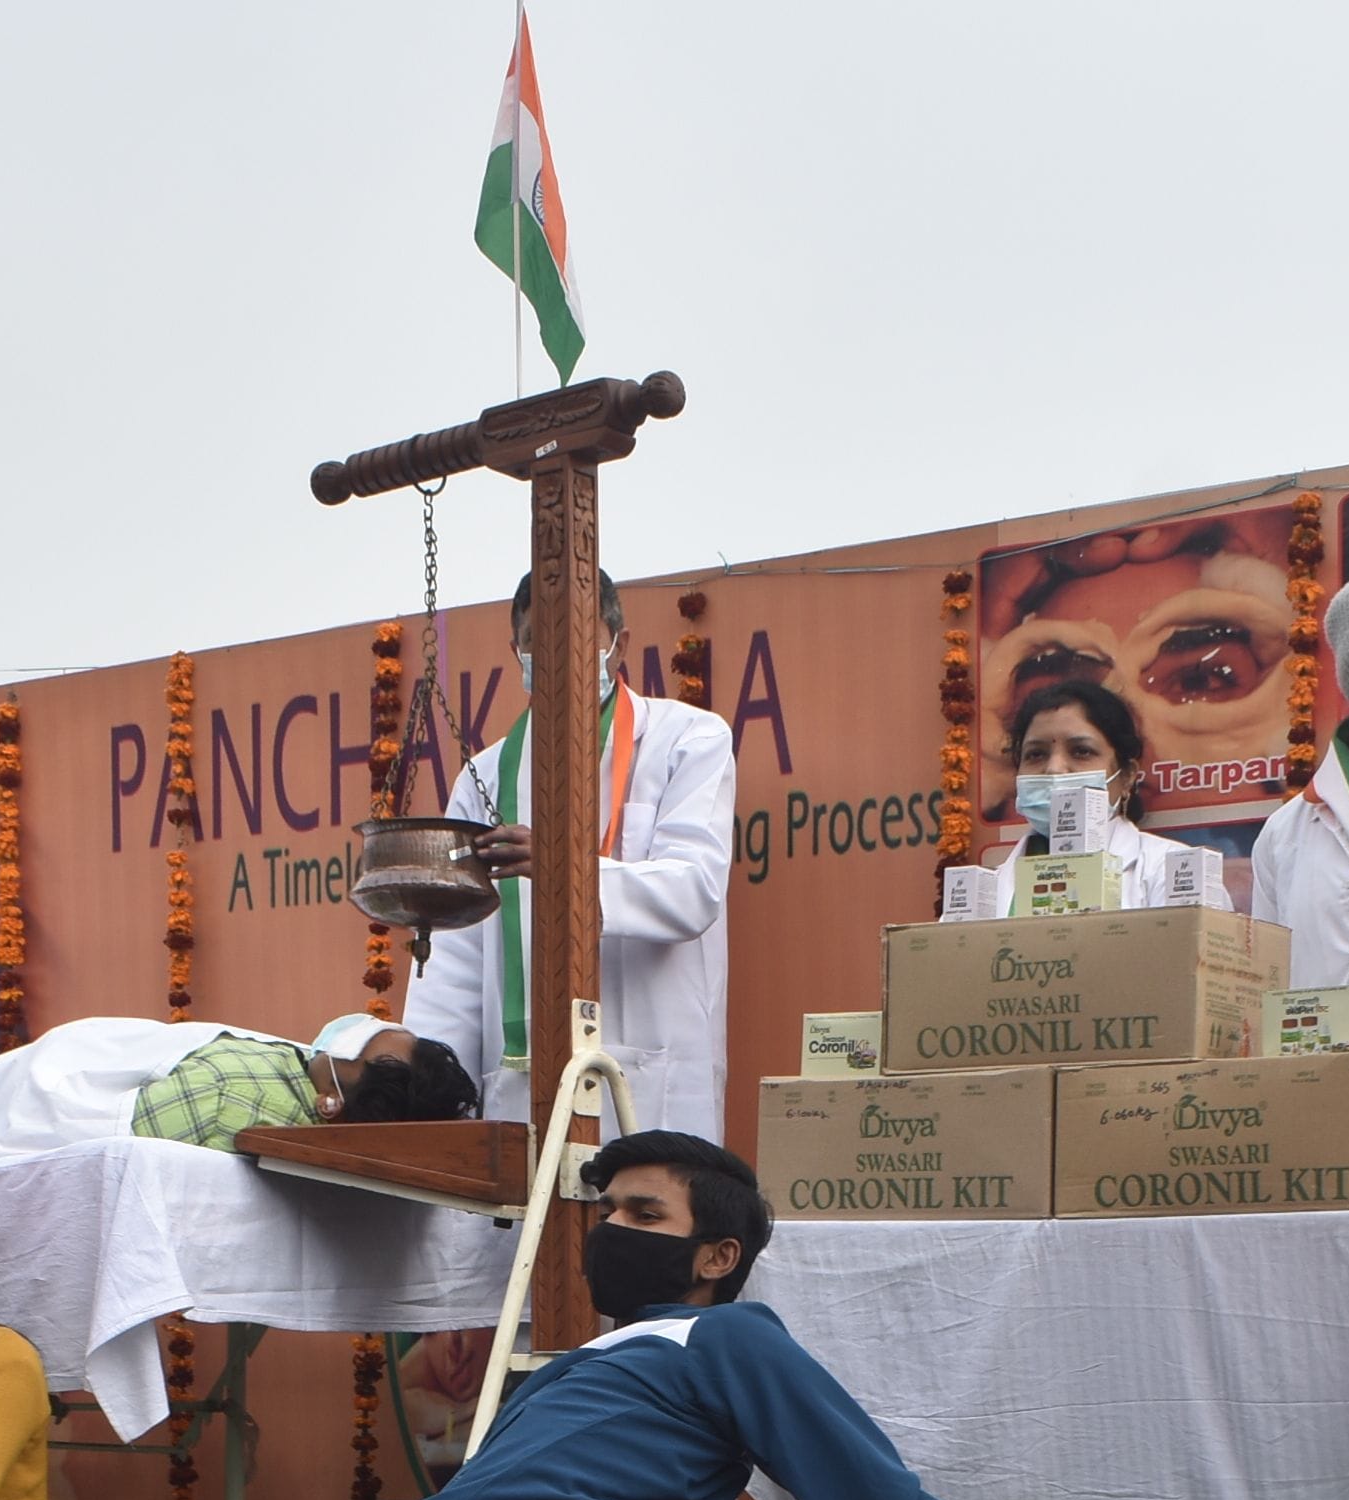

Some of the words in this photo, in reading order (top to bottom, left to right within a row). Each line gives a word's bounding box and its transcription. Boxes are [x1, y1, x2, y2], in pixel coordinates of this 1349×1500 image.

[111, 630, 793, 853] PANCHAKA
[228, 852, 254, 913] A
[263, 842, 364, 909] Timel
[787, 788, 945, 858] Process
[990, 948, 1075, 988] Divya
[986, 994, 1081, 1018] SWASARI
[916, 1020, 1083, 1060] CORONIL
[1092, 1015, 1159, 1050] KIT
[860, 1104, 937, 1145] Divya
[1173, 1094, 1262, 1137] Divya
[856, 1152, 942, 1174] SWASARI
[1169, 1143, 1270, 1168] SWASARI
[789, 1177, 943, 1211] CORONIL
[952, 1175, 1013, 1208] KIT
[1094, 1170, 1272, 1208] CORONIL
